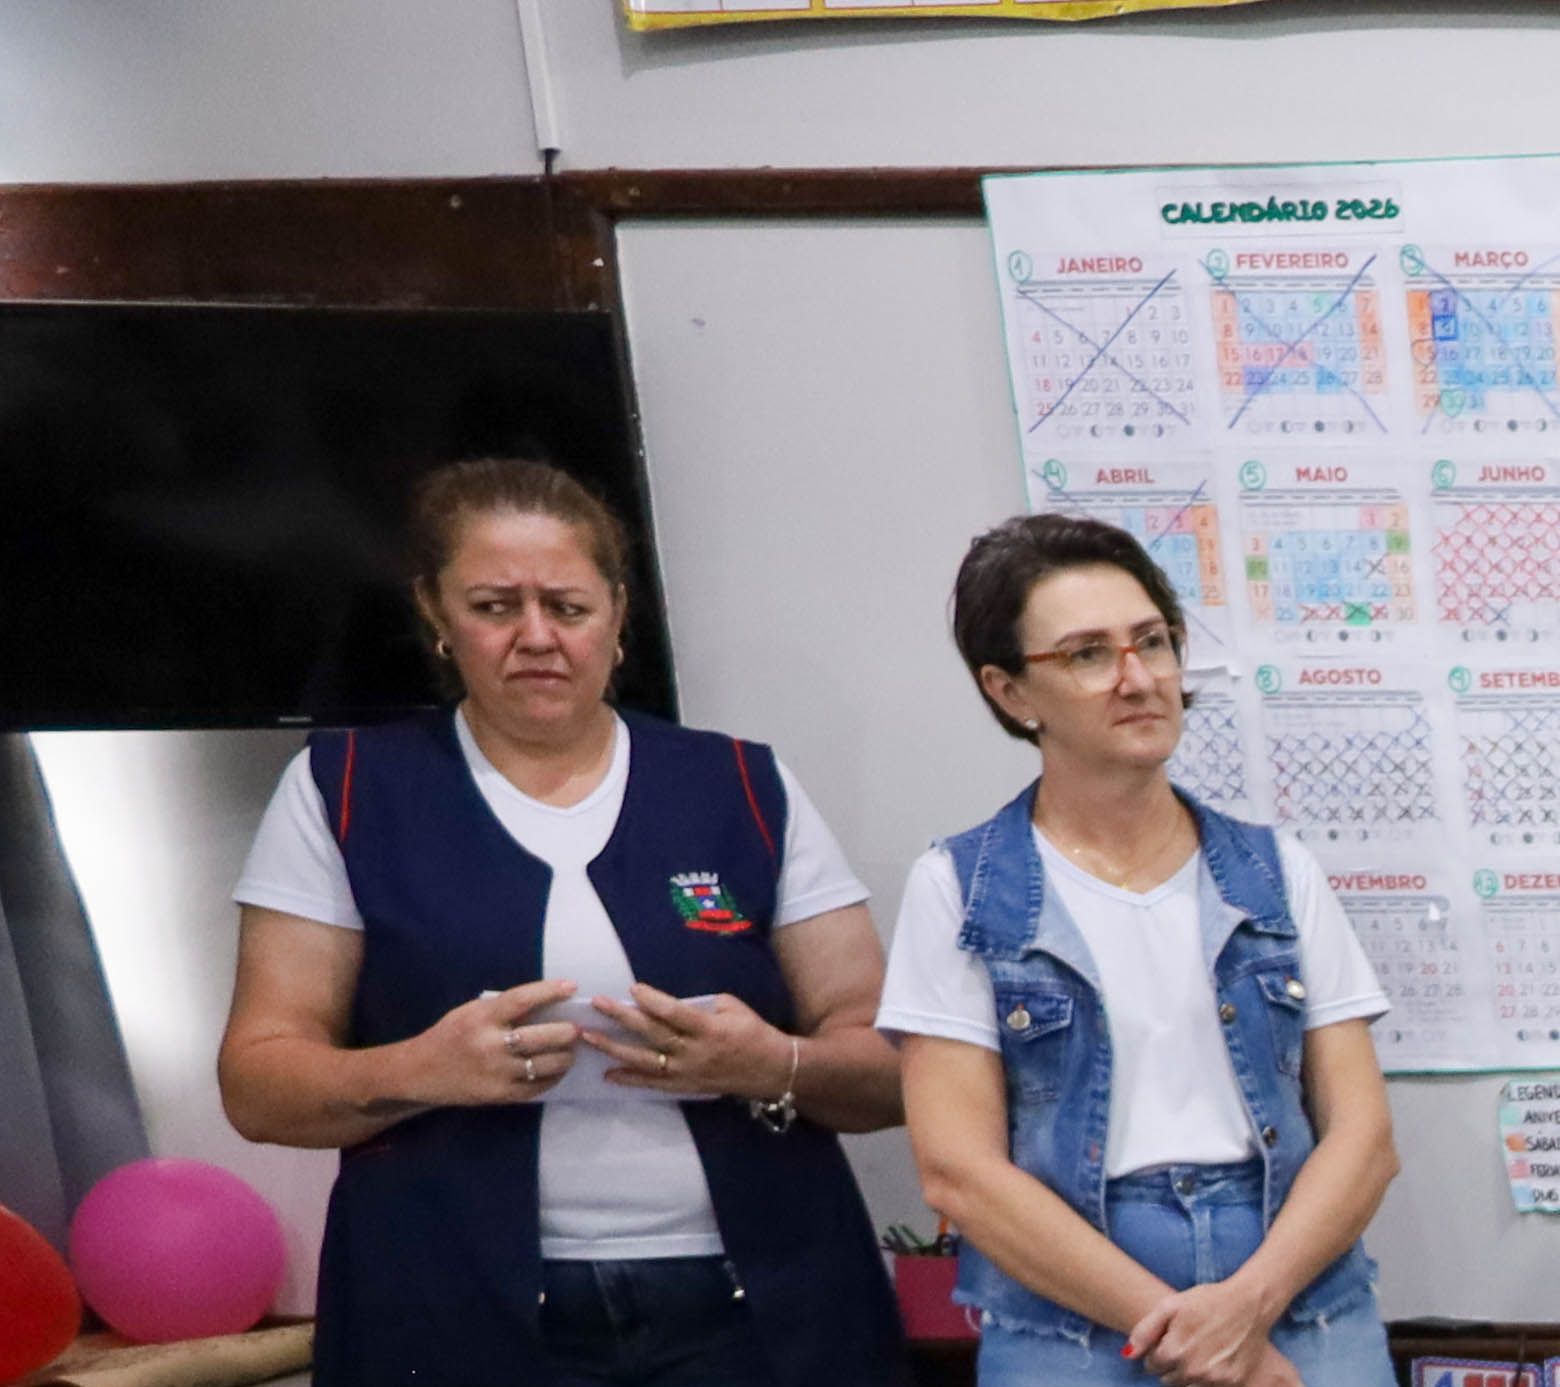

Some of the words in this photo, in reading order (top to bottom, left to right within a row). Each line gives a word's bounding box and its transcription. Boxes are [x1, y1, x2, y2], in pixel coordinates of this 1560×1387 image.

[1162, 196, 1327, 225] CALENDÁRIO
[1335, 199, 1400, 220] 2026
[1056, 256, 1143, 274] JANEIRO
[1236, 251, 1349, 269] FEVEREIRO
[1454, 250, 1529, 269] MARÇO
[1095, 468, 1154, 485] ABRIL
[1296, 466, 1348, 483] MAIO
[1478, 466, 1545, 483] JUNHO
[1300, 669, 1381, 685] AGOSTO
